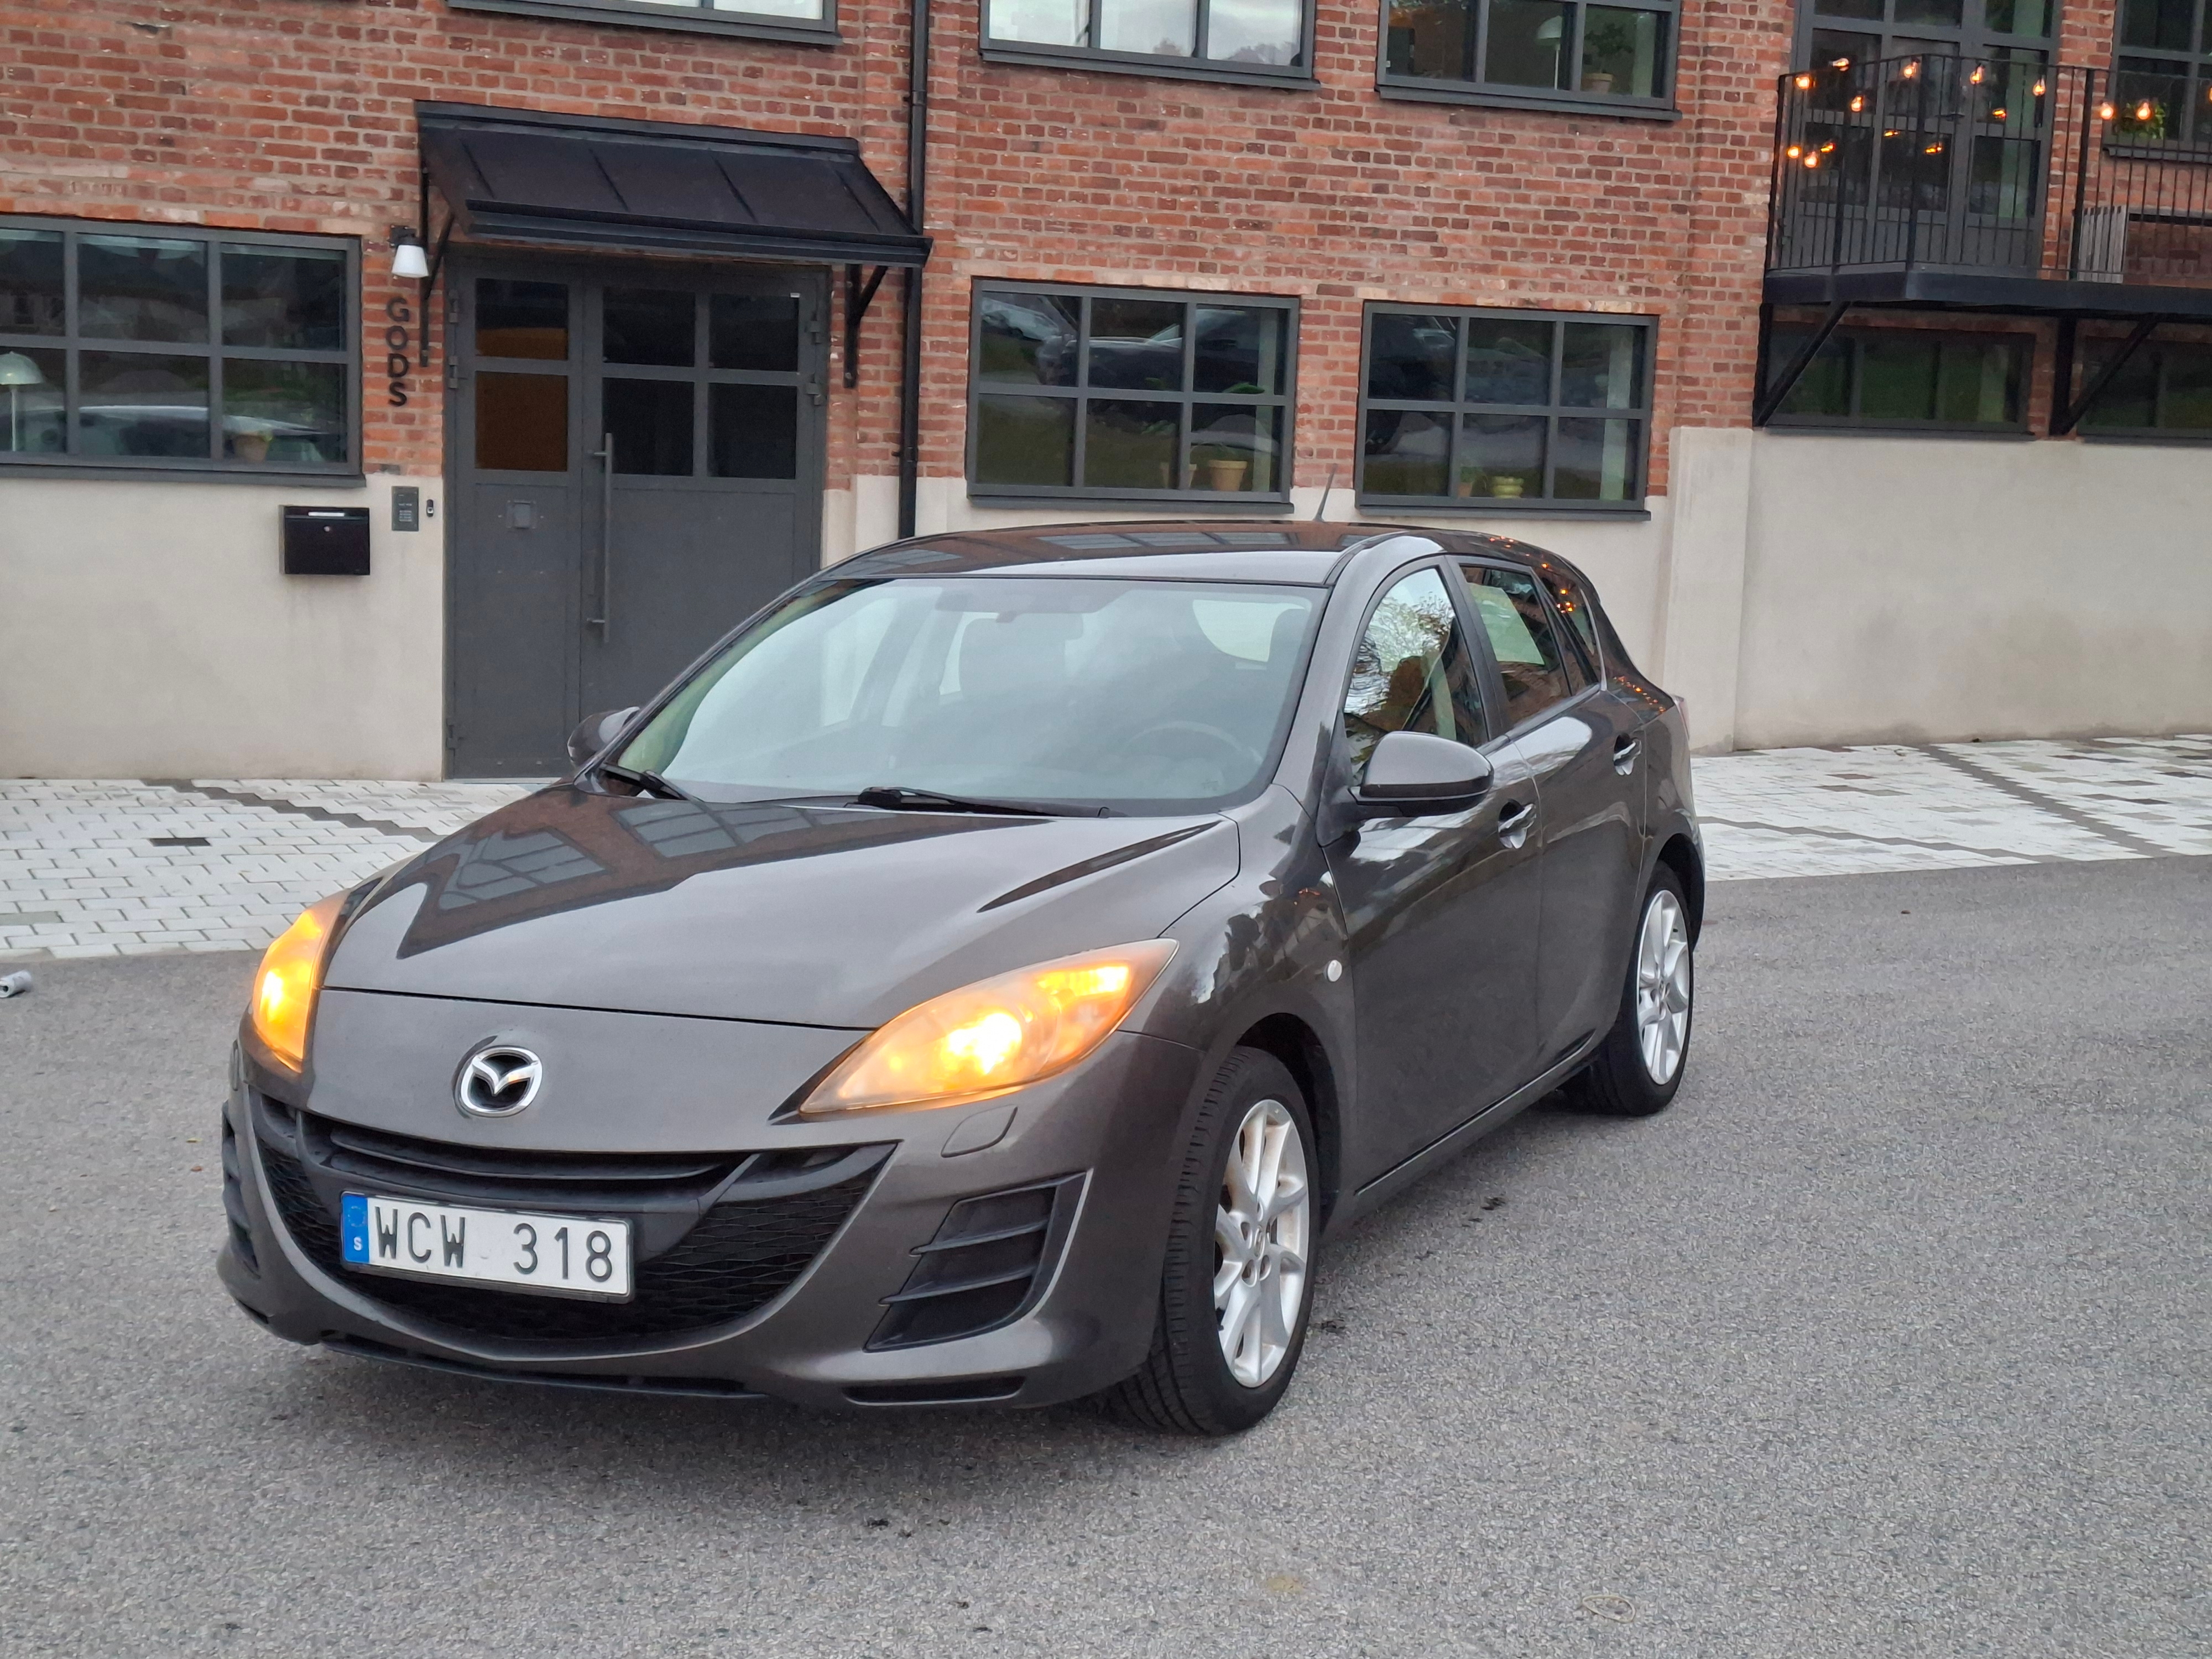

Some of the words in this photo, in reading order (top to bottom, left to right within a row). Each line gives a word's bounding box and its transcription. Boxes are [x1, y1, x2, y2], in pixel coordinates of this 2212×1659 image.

[386, 297, 409, 406] GODS
[354, 1237, 363, 1251] S
[374, 1206, 466, 1268] WCW
[513, 1222, 613, 1283] 318
